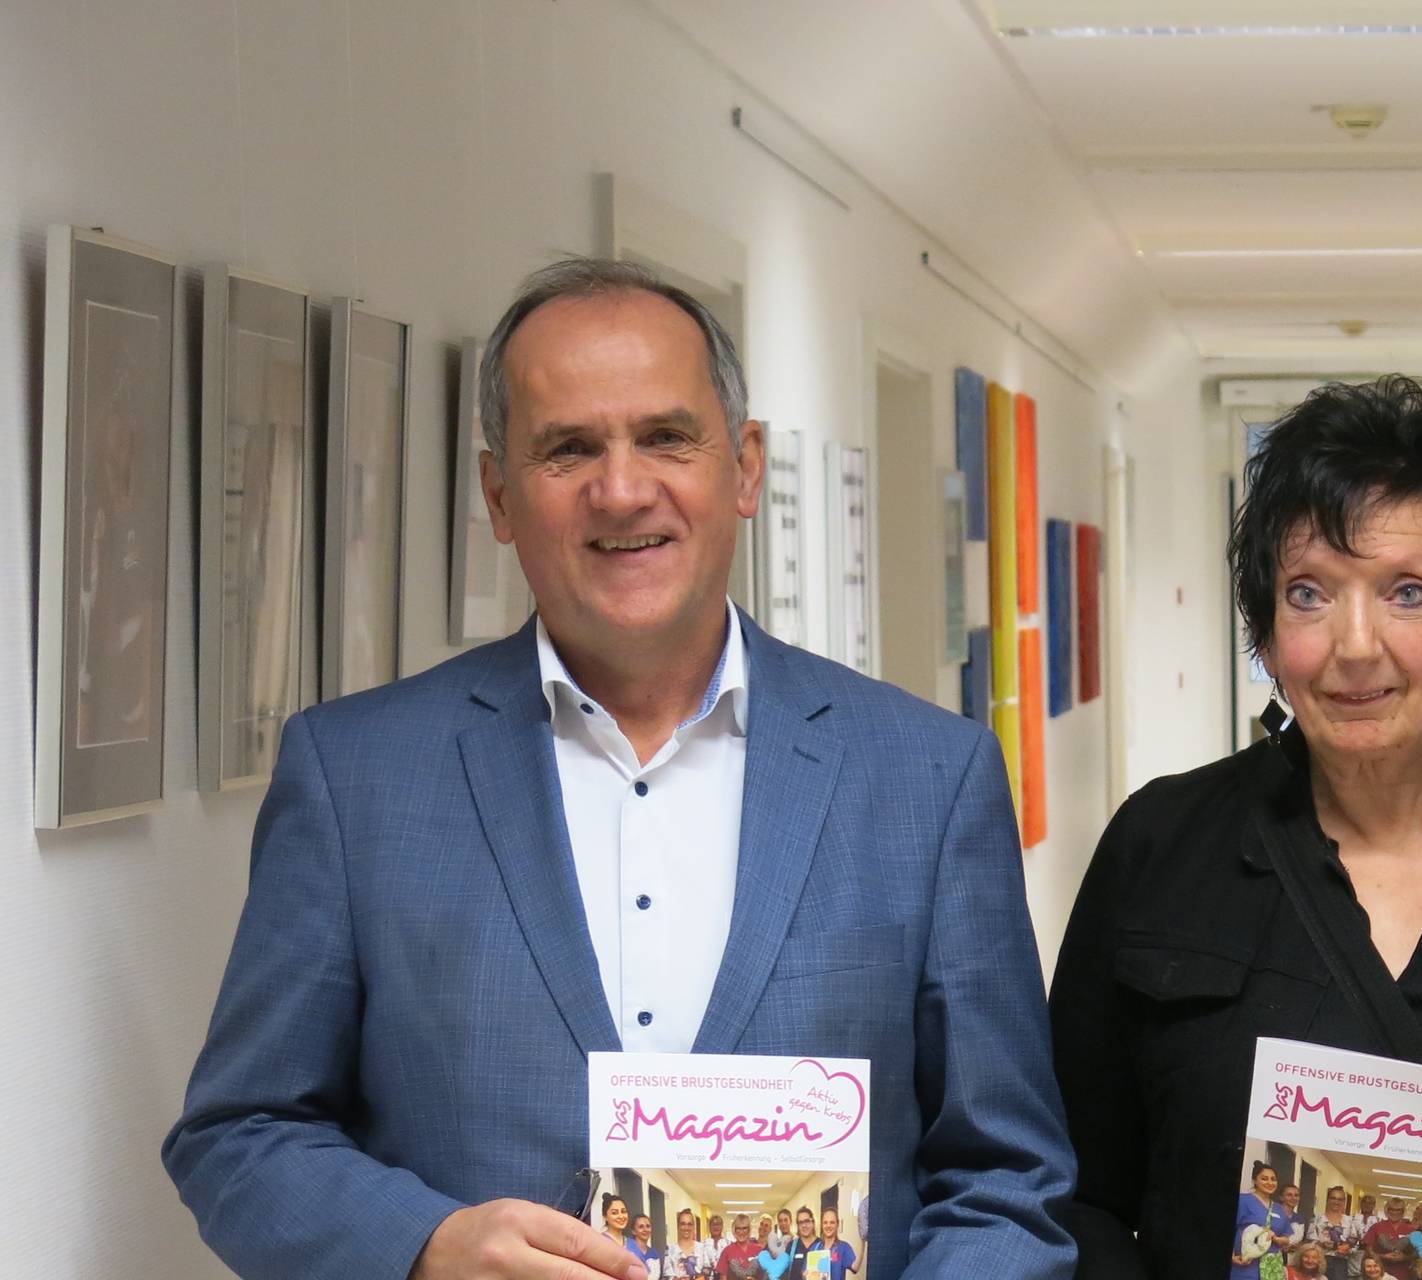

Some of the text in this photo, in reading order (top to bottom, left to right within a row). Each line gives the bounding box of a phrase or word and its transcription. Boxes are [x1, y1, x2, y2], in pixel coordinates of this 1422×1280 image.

[610, 1075, 794, 1090] OFFENSIVE BRUSTGESUNDHEIT
[1275, 1062, 1345, 1082] OFFENSIVE
[807, 1086, 839, 1105] Aktiv
[1263, 1082, 1293, 1120] Das
[605, 1098, 632, 1141] Das
[789, 1098, 852, 1125] gegen Krebs
[632, 1097, 823, 1161] Magazin
